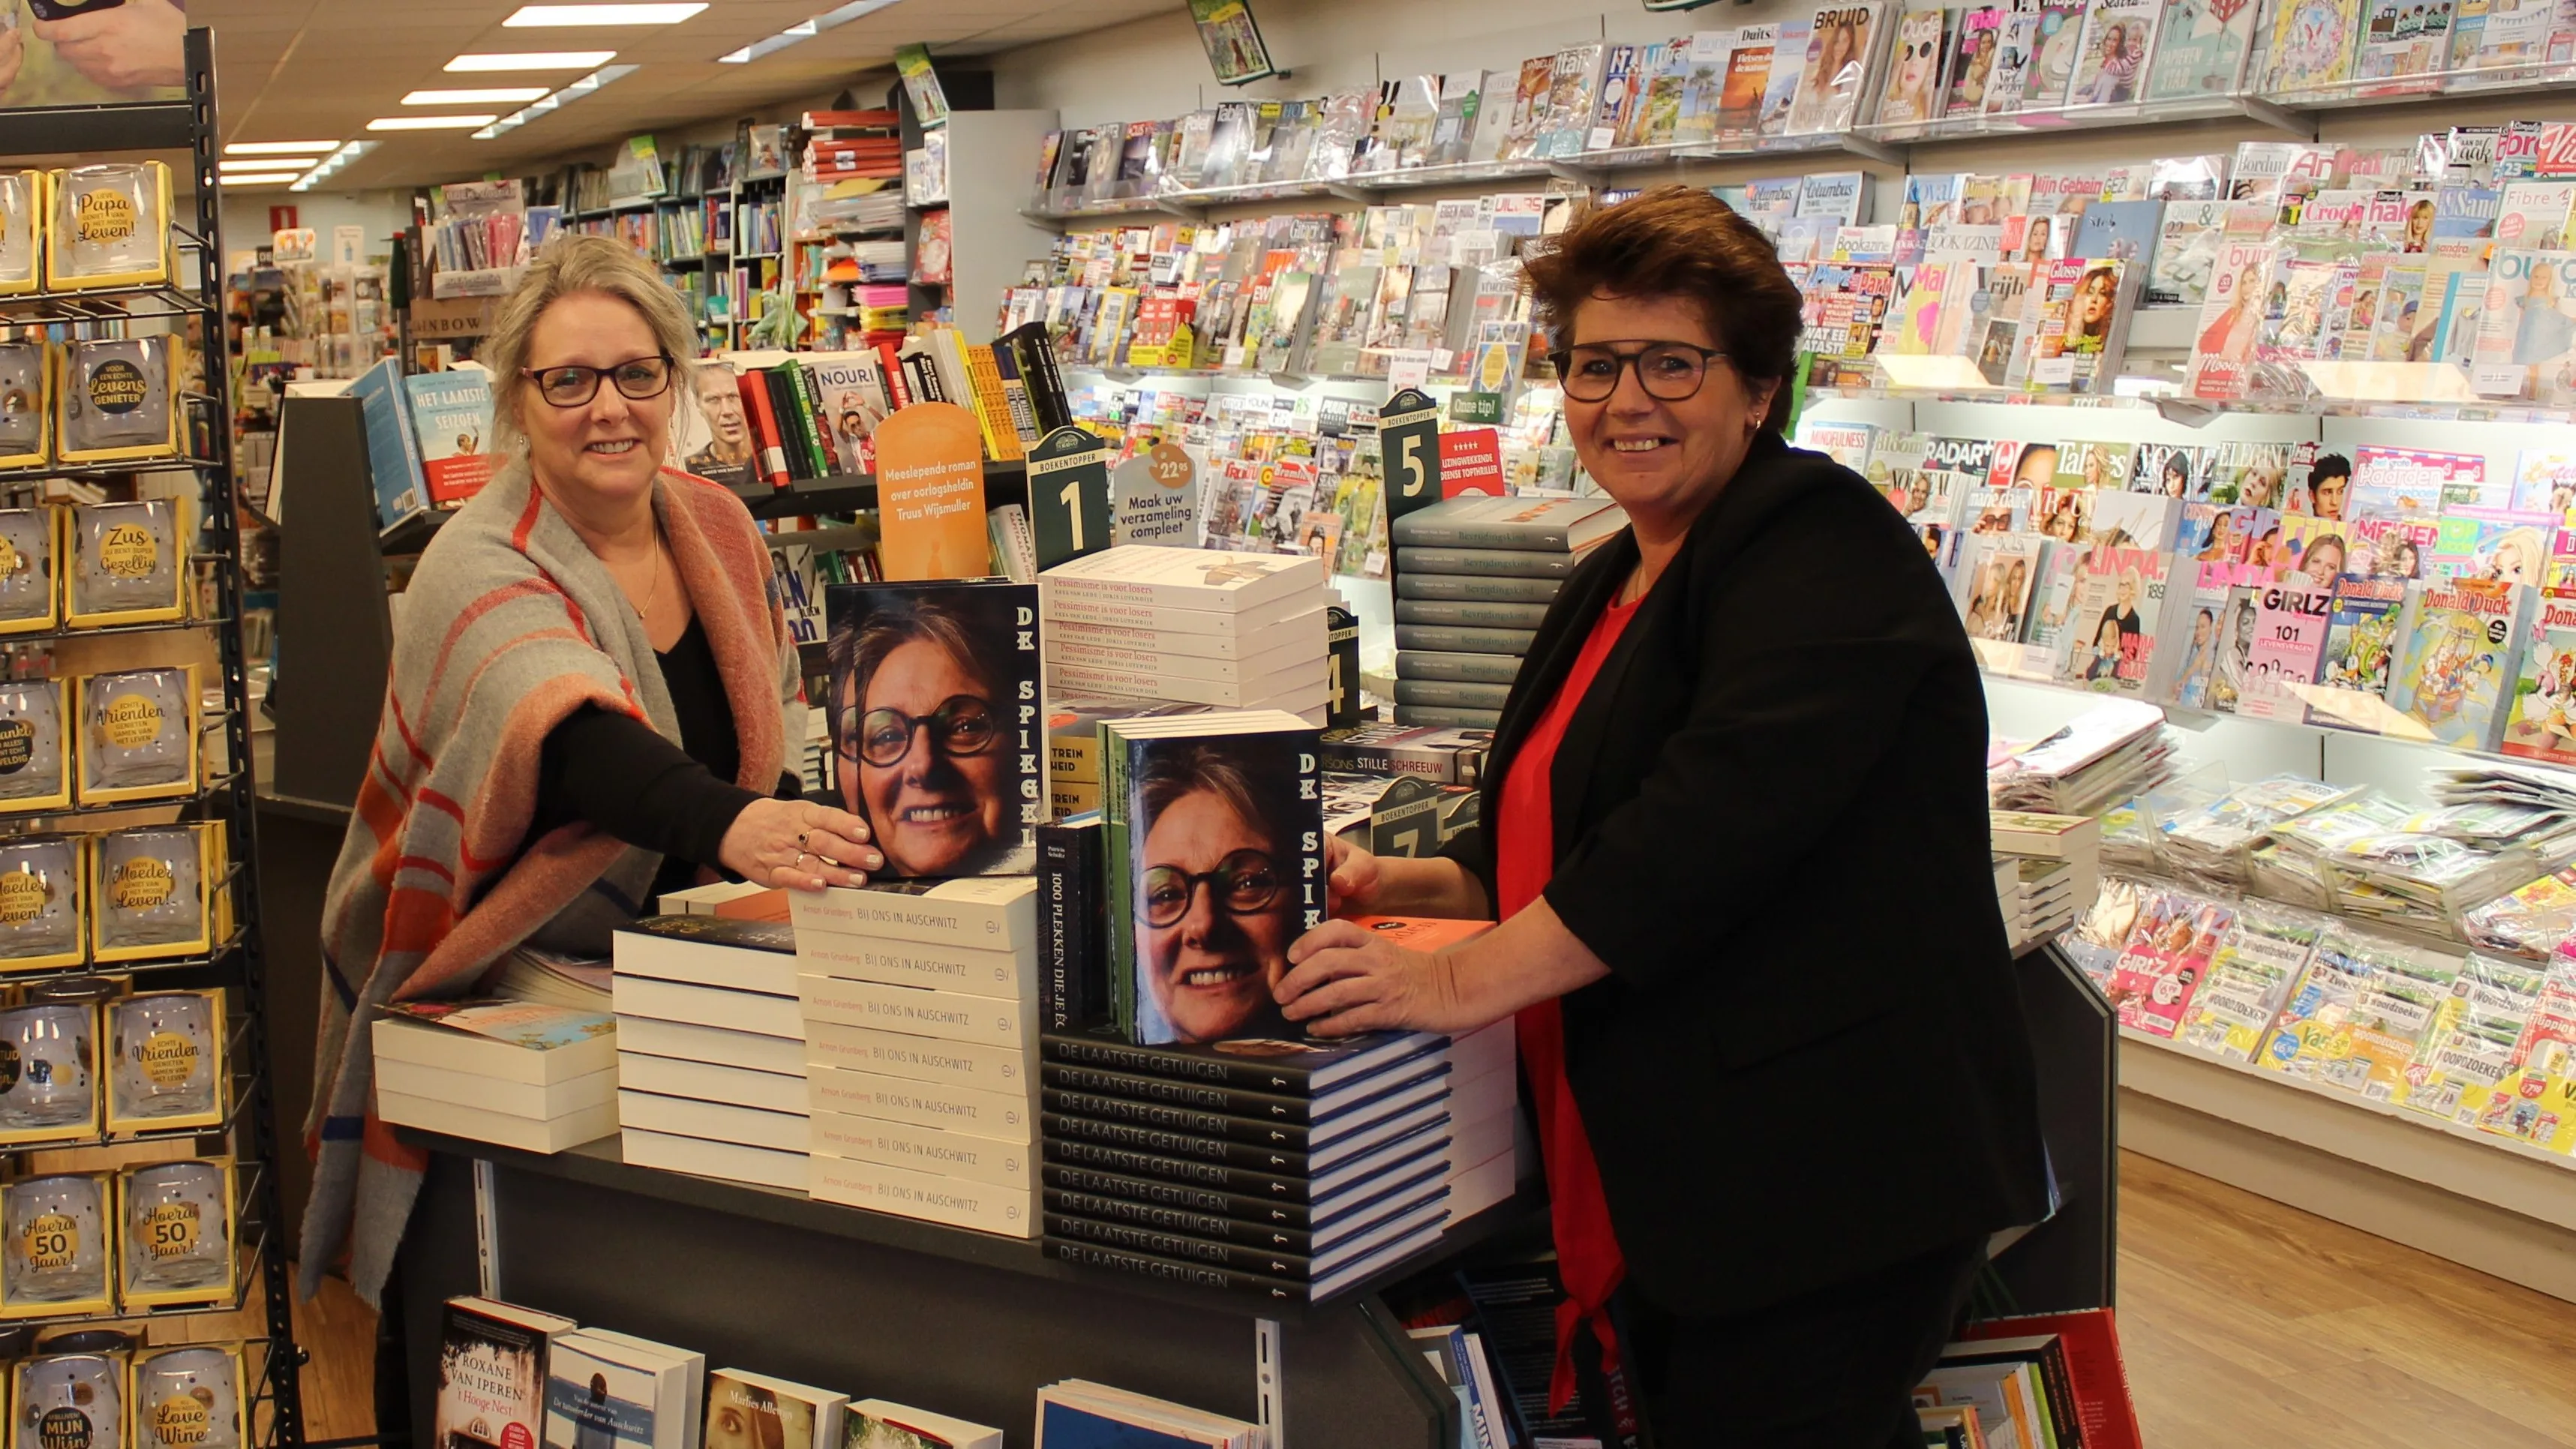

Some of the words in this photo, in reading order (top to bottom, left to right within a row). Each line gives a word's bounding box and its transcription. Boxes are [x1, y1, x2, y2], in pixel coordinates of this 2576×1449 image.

[1814, 8, 1869, 29] BRUID
[1901, 15, 1941, 40] Oude
[77, 192, 131, 214] Papa
[2368, 199, 2412, 222] hak
[78, 221, 135, 242] Leven!
[88, 378, 148, 396] Levens
[821, 368, 875, 386] NOURI
[94, 394, 141, 405] GENIETER
[416, 393, 438, 408] HET
[442, 388, 487, 405] LAATSTE
[1455, 399, 1476, 413] Onze
[1478, 400, 1496, 415] tip!
[435, 413, 481, 430] SEIZOEN
[1388, 411, 1431, 428] BOEKENTOPPER
[1810, 430, 1866, 448] MINDFULNESS
[1040, 454, 1096, 471] BOEKENTOPPER
[1402, 435, 1425, 496] 5
[2056, 441, 2127, 478] Tales
[885, 463, 946, 482] Meeslepende
[947, 460, 976, 471] roman
[1463, 466, 1498, 479] TOPTHRILLER
[890, 488, 911, 501] over
[913, 480, 974, 500] oorlogsheldin
[896, 507, 923, 520] Truus
[924, 500, 971, 519] Wijsmuller
[1129, 496, 1161, 510] Maak
[1165, 495, 1183, 506] uw
[1060, 481, 1084, 551] 1
[1120, 507, 1192, 526] verzameling
[109, 528, 149, 548] Zus
[1130, 522, 1183, 538] compleet
[1458, 532, 1527, 544] Bevrijdingskind
[101, 556, 157, 575] Gezellig
[1054, 578, 1100, 590] Pessimisme
[1101, 581, 1108, 591] is
[1109, 584, 1127, 592] voor
[1129, 584, 1153, 594] losers
[2338, 578, 2374, 597] Donald
[2377, 581, 2403, 599] Duck
[2264, 589, 2328, 616] GIRLZ
[2424, 587, 2471, 614] Donald
[2474, 589, 2511, 615] Duck
[2544, 604, 2576, 627] Dona
[1016, 606, 1035, 650] DE
[2275, 626, 2300, 642] 101
[1061, 644, 1105, 656] Pessimisme
[1106, 648, 1113, 657] is
[1115, 652, 1132, 660] voor
[1133, 650, 1157, 662] losers
[1059, 668, 1105, 680] Pessimisme
[1106, 673, 1113, 682] is
[1133, 675, 1158, 687] losers
[1327, 654, 1345, 714] 4
[95, 706, 166, 725] Vrienden
[116, 721, 148, 729] GENIETEN
[0, 724, 33, 739] ankt
[113, 729, 137, 737] SAMEN
[1051, 748, 1083, 760] TREIN
[1019, 680, 1039, 849] SPIEGEL
[1050, 760, 1075, 772] HEID
[1389, 759, 1443, 775] SCHREEUW
[1299, 753, 1318, 800] DE
[1380, 800, 1430, 823] BOEKENTOPPER
[1393, 829, 1419, 858] 7
[113, 865, 174, 884] Moeder
[1302, 831, 1321, 931] SPIE
[1052, 872, 1063, 901] 1000
[115, 892, 171, 909] Leven!
[803, 905, 821, 914] Arnon
[824, 906, 852, 919] Grunberg
[857, 908, 869, 920] BIJ
[872, 909, 891, 922] ONS
[893, 912, 903, 923] IN
[906, 913, 957, 929] AUSCHWITZ
[1052, 904, 1064, 967] PLEKKEN
[2115, 951, 2169, 978] GIRLZ
[1054, 968, 1064, 992] DIE
[1055, 994, 1065, 1011] JE
[868, 1001, 880, 1015] BIJ
[882, 1004, 902, 1016] ONS
[904, 1006, 914, 1018] IN
[917, 1008, 969, 1025] AUSCHWITZ
[1055, 1012, 1067, 1030] ÉC
[132, 1045, 201, 1063] Vrienden
[153, 1058, 184, 1067] GENIETEN
[1059, 1043, 1078, 1059] DE
[1082, 1046, 1146, 1066] LAATSTE
[1150, 1056, 1228, 1078] GETUIGEN
[151, 1067, 174, 1076] SAMEN
[167, 1073, 188, 1082] LEVEN
[876, 1093, 888, 1106] BIJ
[890, 1094, 910, 1108] ONS
[912, 1098, 922, 1109] IN
[925, 1100, 977, 1118] AUSCHWITZ
[1059, 1094, 1079, 1109] DE
[1083, 1096, 1146, 1120] LAATSTE
[1150, 1108, 1227, 1132] GETUIGEN
[143, 1206, 195, 1226] Hoera
[24, 1219, 76, 1238] Hoera
[155, 1222, 187, 1244] 50
[35, 1234, 68, 1255] 50
[149, 1241, 195, 1262] Jaar!
[29, 1250, 75, 1274] Jaar!
[1060, 1245, 1079, 1262] DE
[1083, 1249, 1146, 1274] LAATSTE
[1150, 1262, 1228, 1288] GETUIGEN
[462, 1354, 512, 1381] ROXANE
[451, 1366, 473, 1387] VAN
[477, 1377, 523, 1401] IPEREN
[464, 1390, 491, 1413] Hooge
[491, 1400, 513, 1417] Nest
[729, 1389, 759, 1409] Marlies
[157, 1404, 206, 1424] Love
[47, 1421, 83, 1435] MIJN
[155, 1426, 207, 1444] Wine
